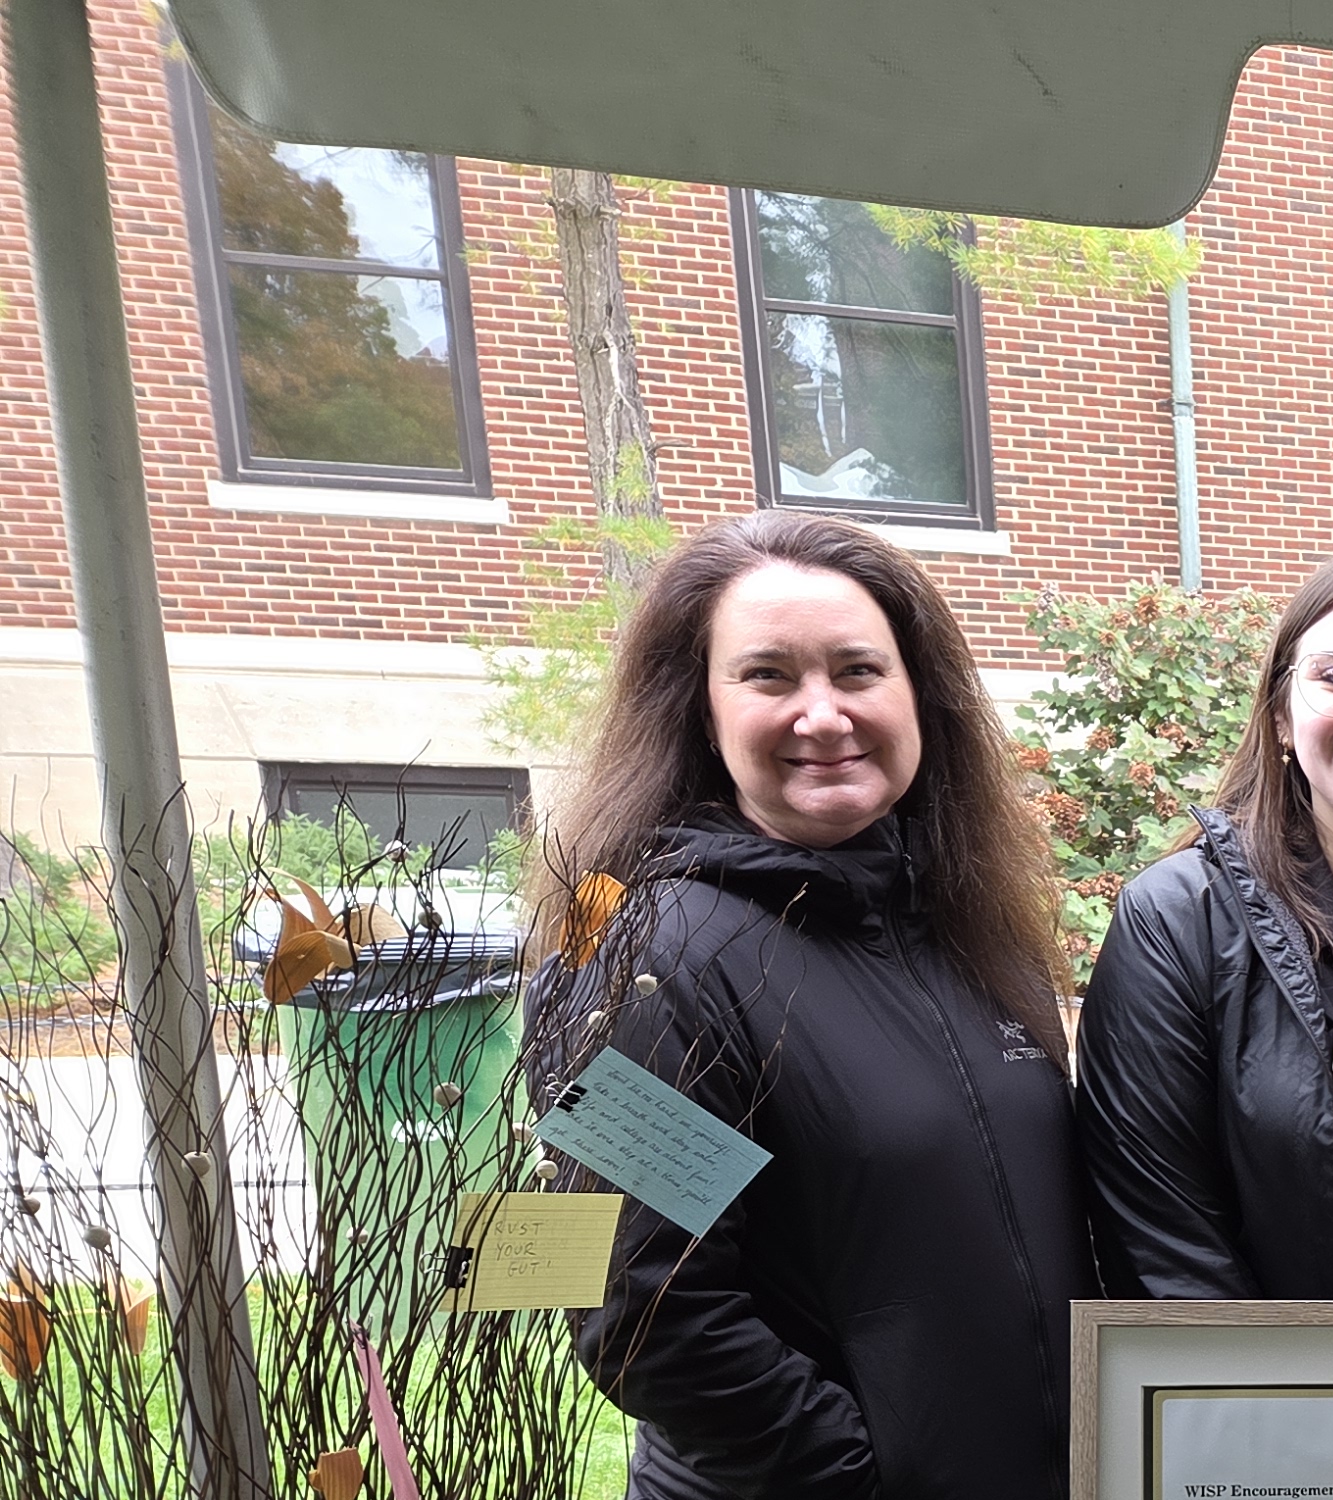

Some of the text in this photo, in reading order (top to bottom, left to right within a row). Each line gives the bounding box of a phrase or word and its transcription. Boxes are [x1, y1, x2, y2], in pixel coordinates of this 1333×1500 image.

[488, 1220, 545, 1236] RUST
[497, 1242, 537, 1261] YOUR
[1185, 1485, 1227, 1497] WISP
